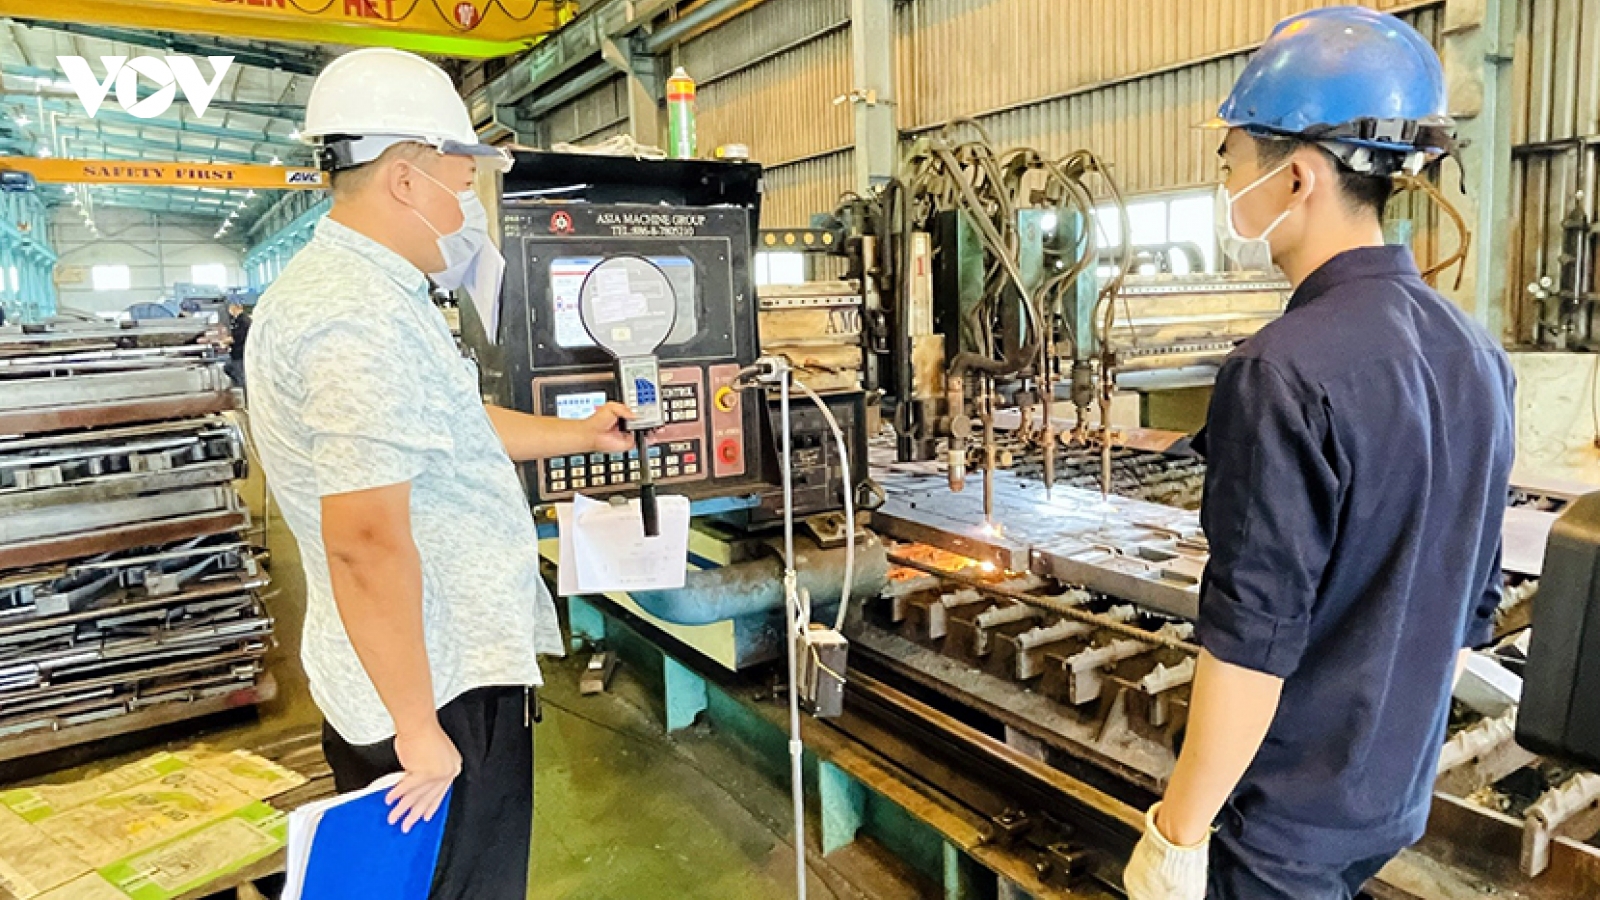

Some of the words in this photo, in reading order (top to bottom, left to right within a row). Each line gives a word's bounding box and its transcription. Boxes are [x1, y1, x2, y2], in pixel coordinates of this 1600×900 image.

[83, 166, 165, 178] SAFETY
[176, 169, 236, 181] FIRST
[596, 214, 621, 224] ASIA
[917, 256, 924, 276] 1
